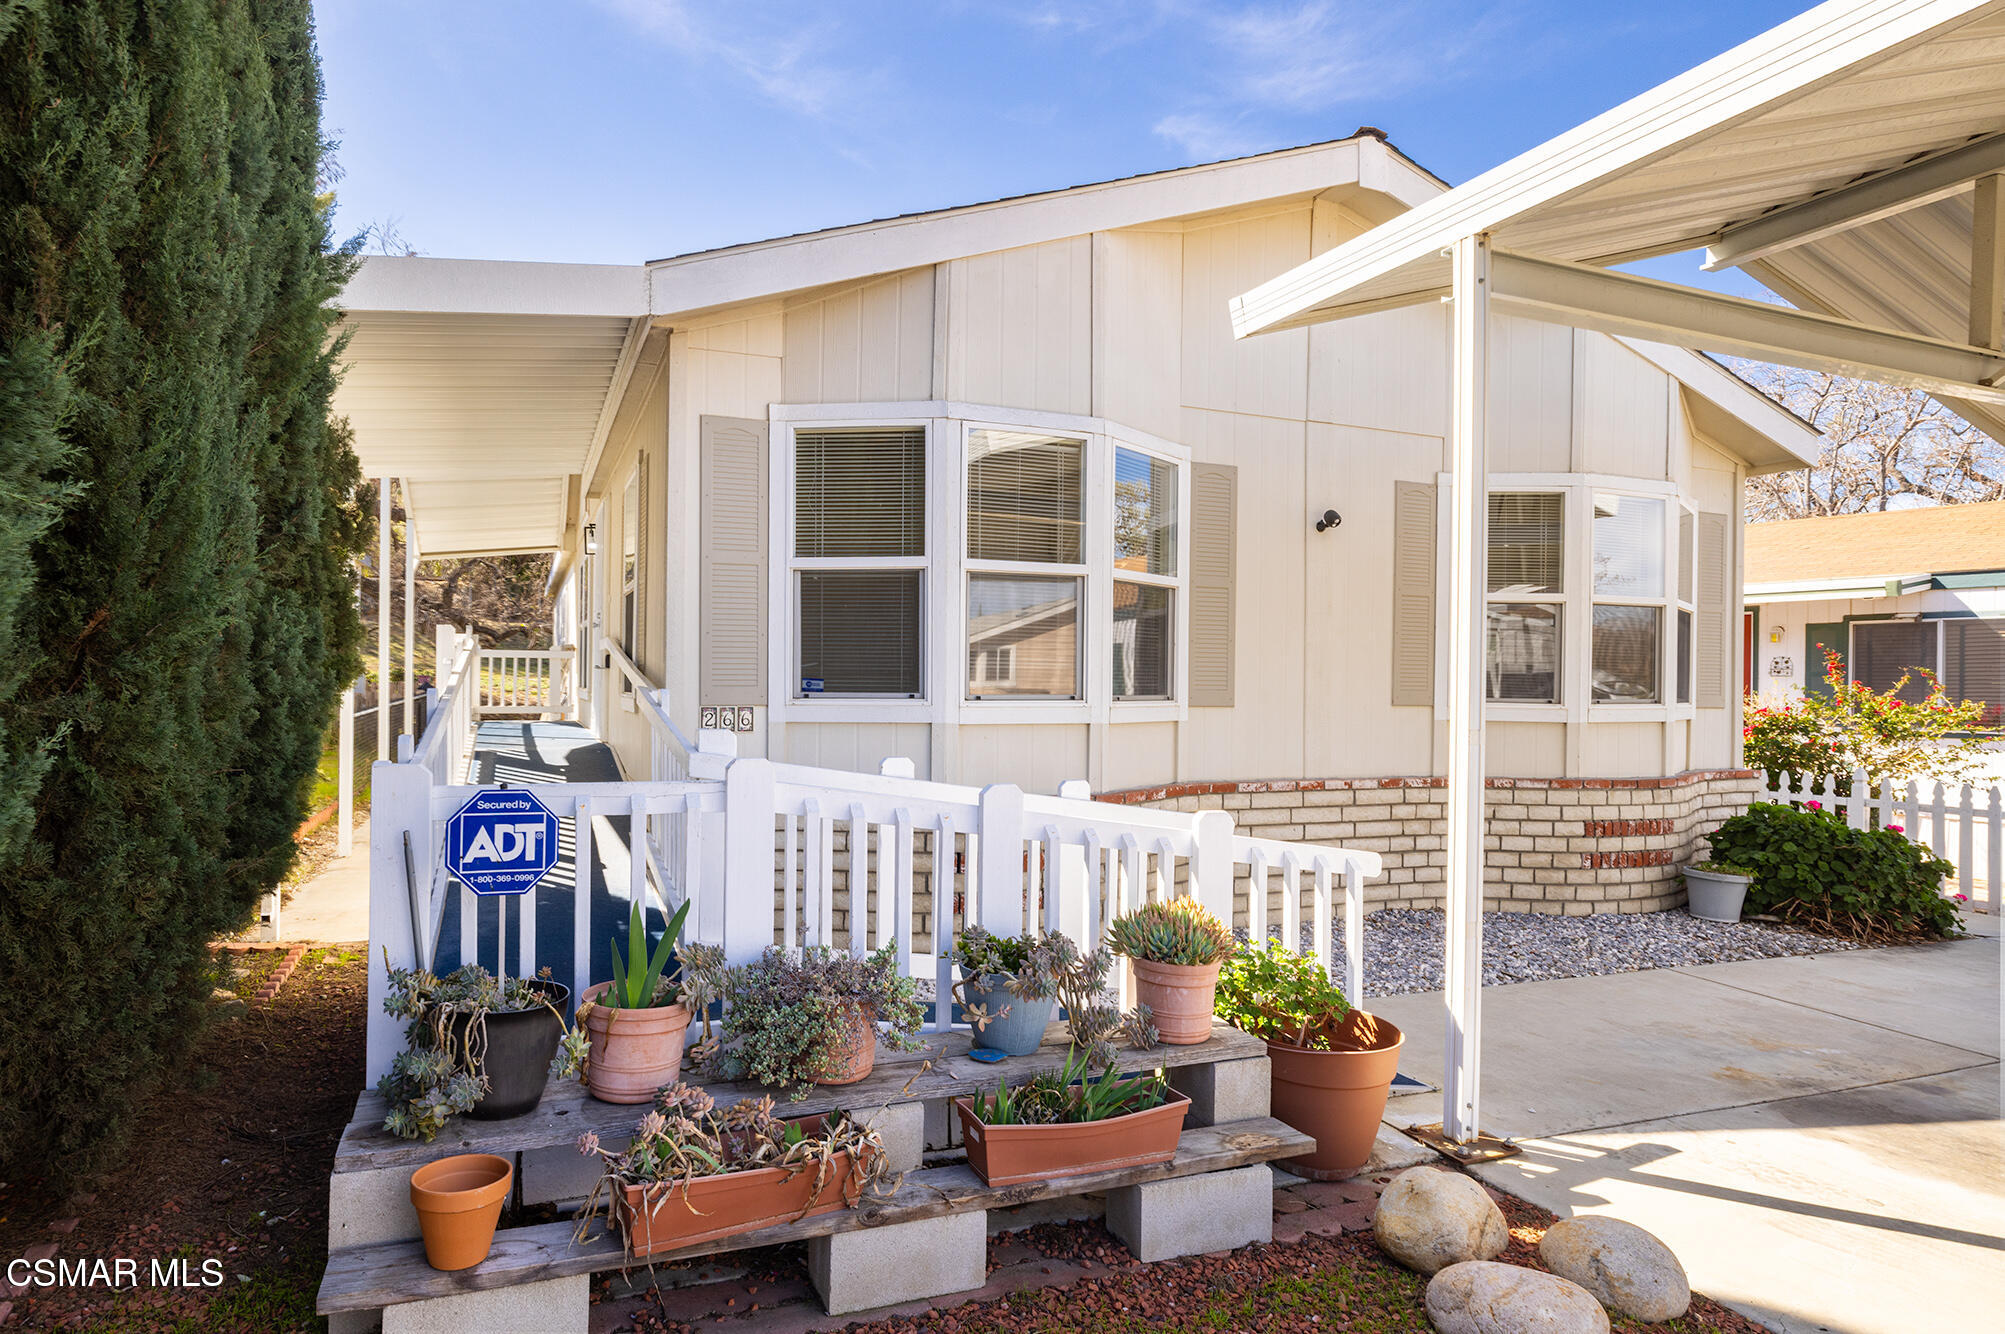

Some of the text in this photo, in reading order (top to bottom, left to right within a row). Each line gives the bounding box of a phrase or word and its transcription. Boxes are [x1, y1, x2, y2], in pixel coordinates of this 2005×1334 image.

[704, 712, 750, 727] 266
[477, 800, 531, 810] Secured by
[462, 823, 544, 864] ADT
[470, 874, 535, 883] 1-800-369-0996
